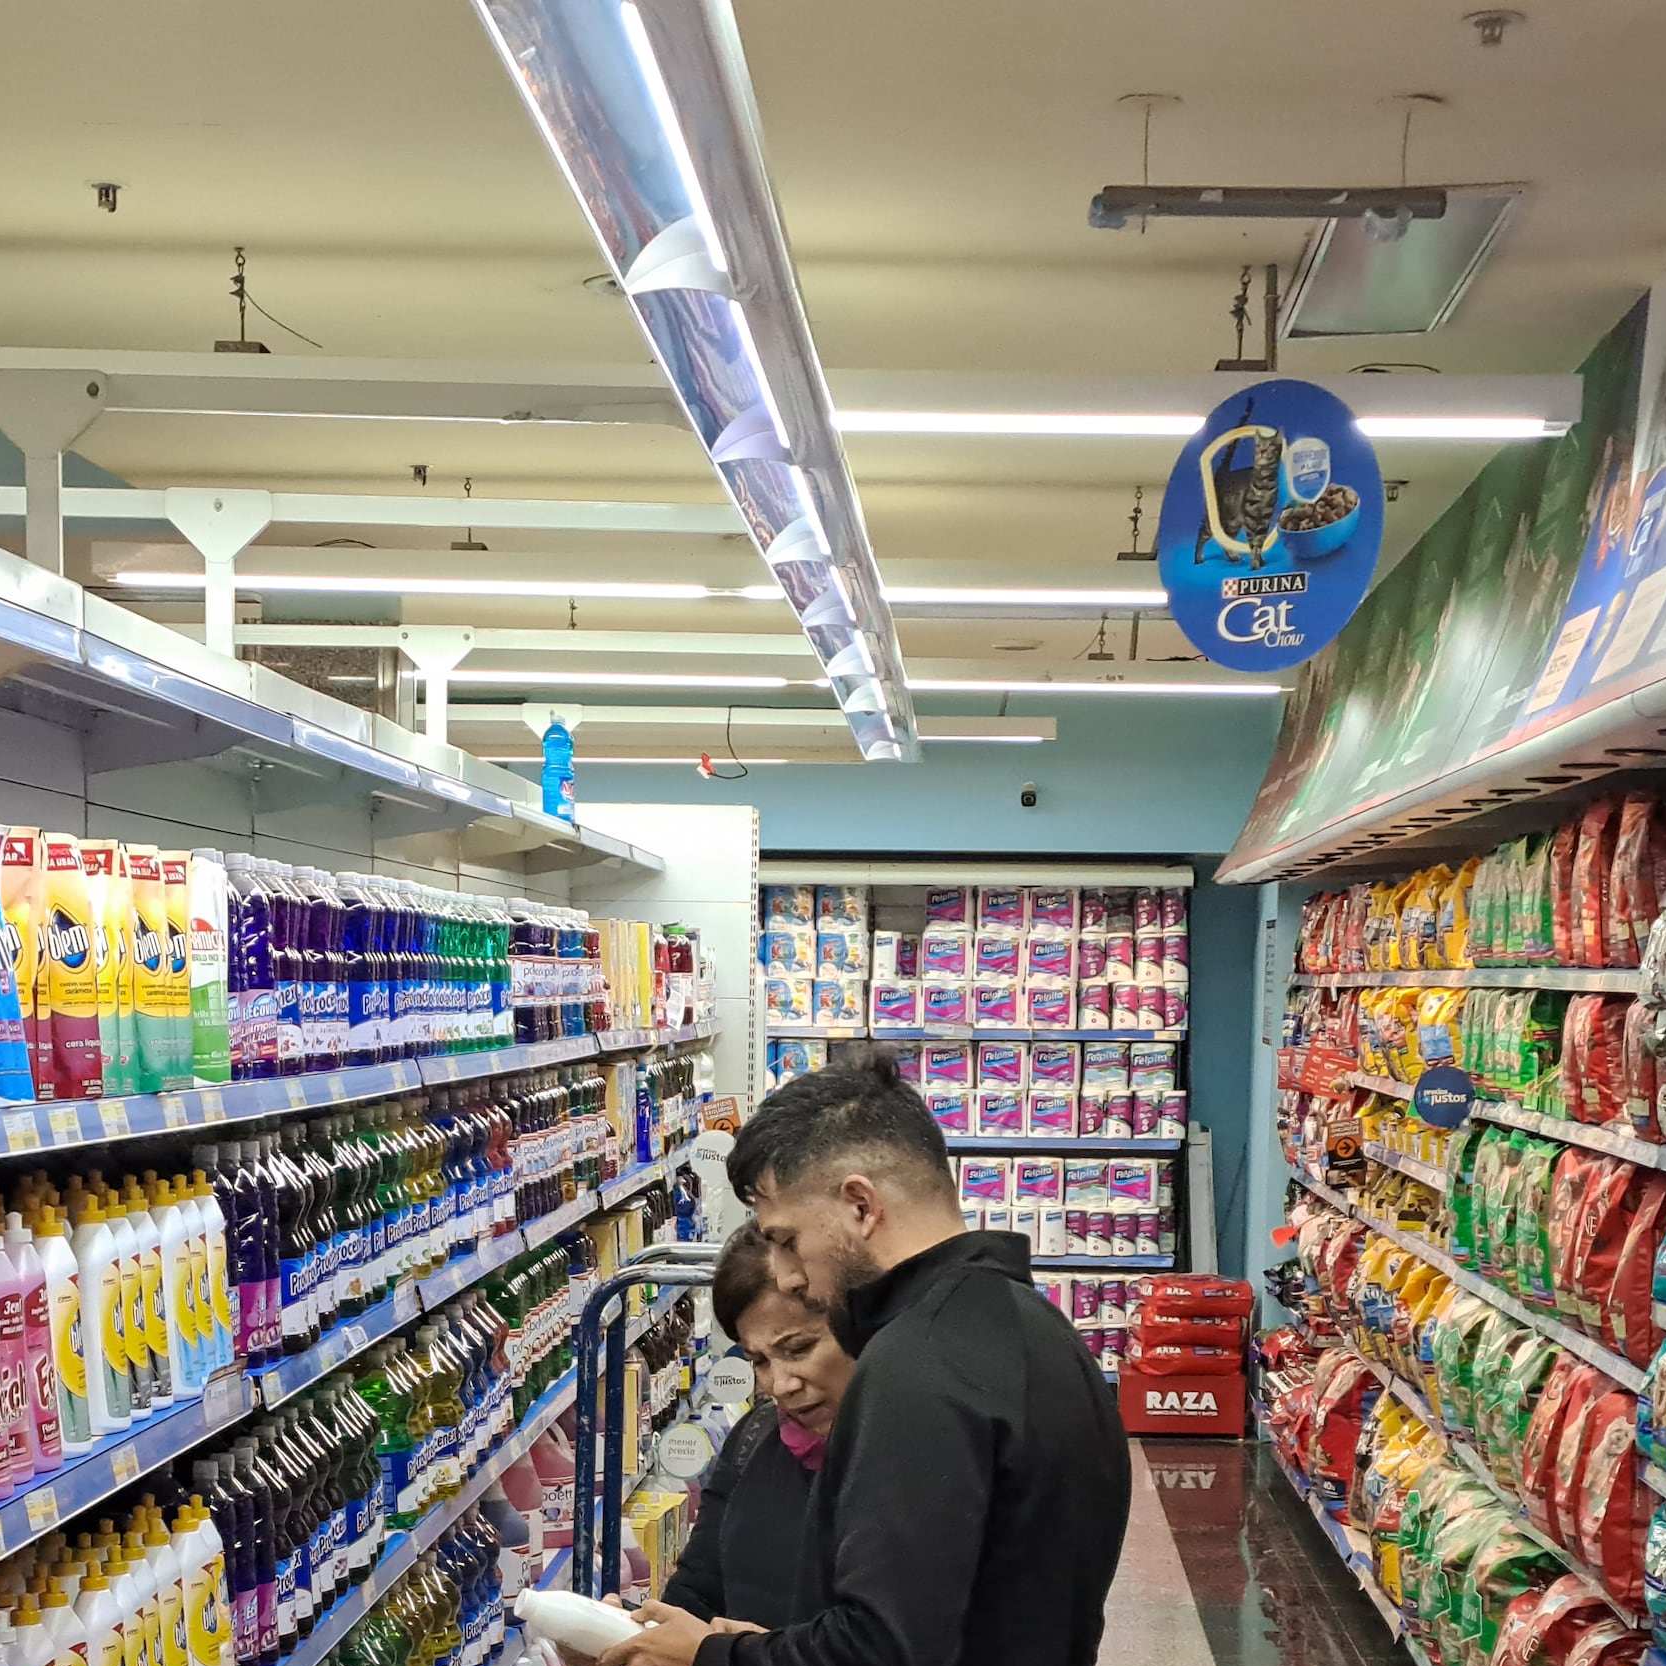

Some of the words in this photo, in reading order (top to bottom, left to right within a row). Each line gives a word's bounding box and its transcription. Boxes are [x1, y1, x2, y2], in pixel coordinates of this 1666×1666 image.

[1239, 575, 1305, 594] PURINA
[1218, 598, 1295, 643] Cat
[1264, 628, 1304, 648] Chow
[48, 924, 88, 960] blem
[135, 927, 165, 960] blem
[1431, 1095, 1466, 1104] justos
[1146, 1391, 1218, 1411] RAZA
[668, 1438, 696, 1447] menor
[668, 1446, 694, 1455] precio
